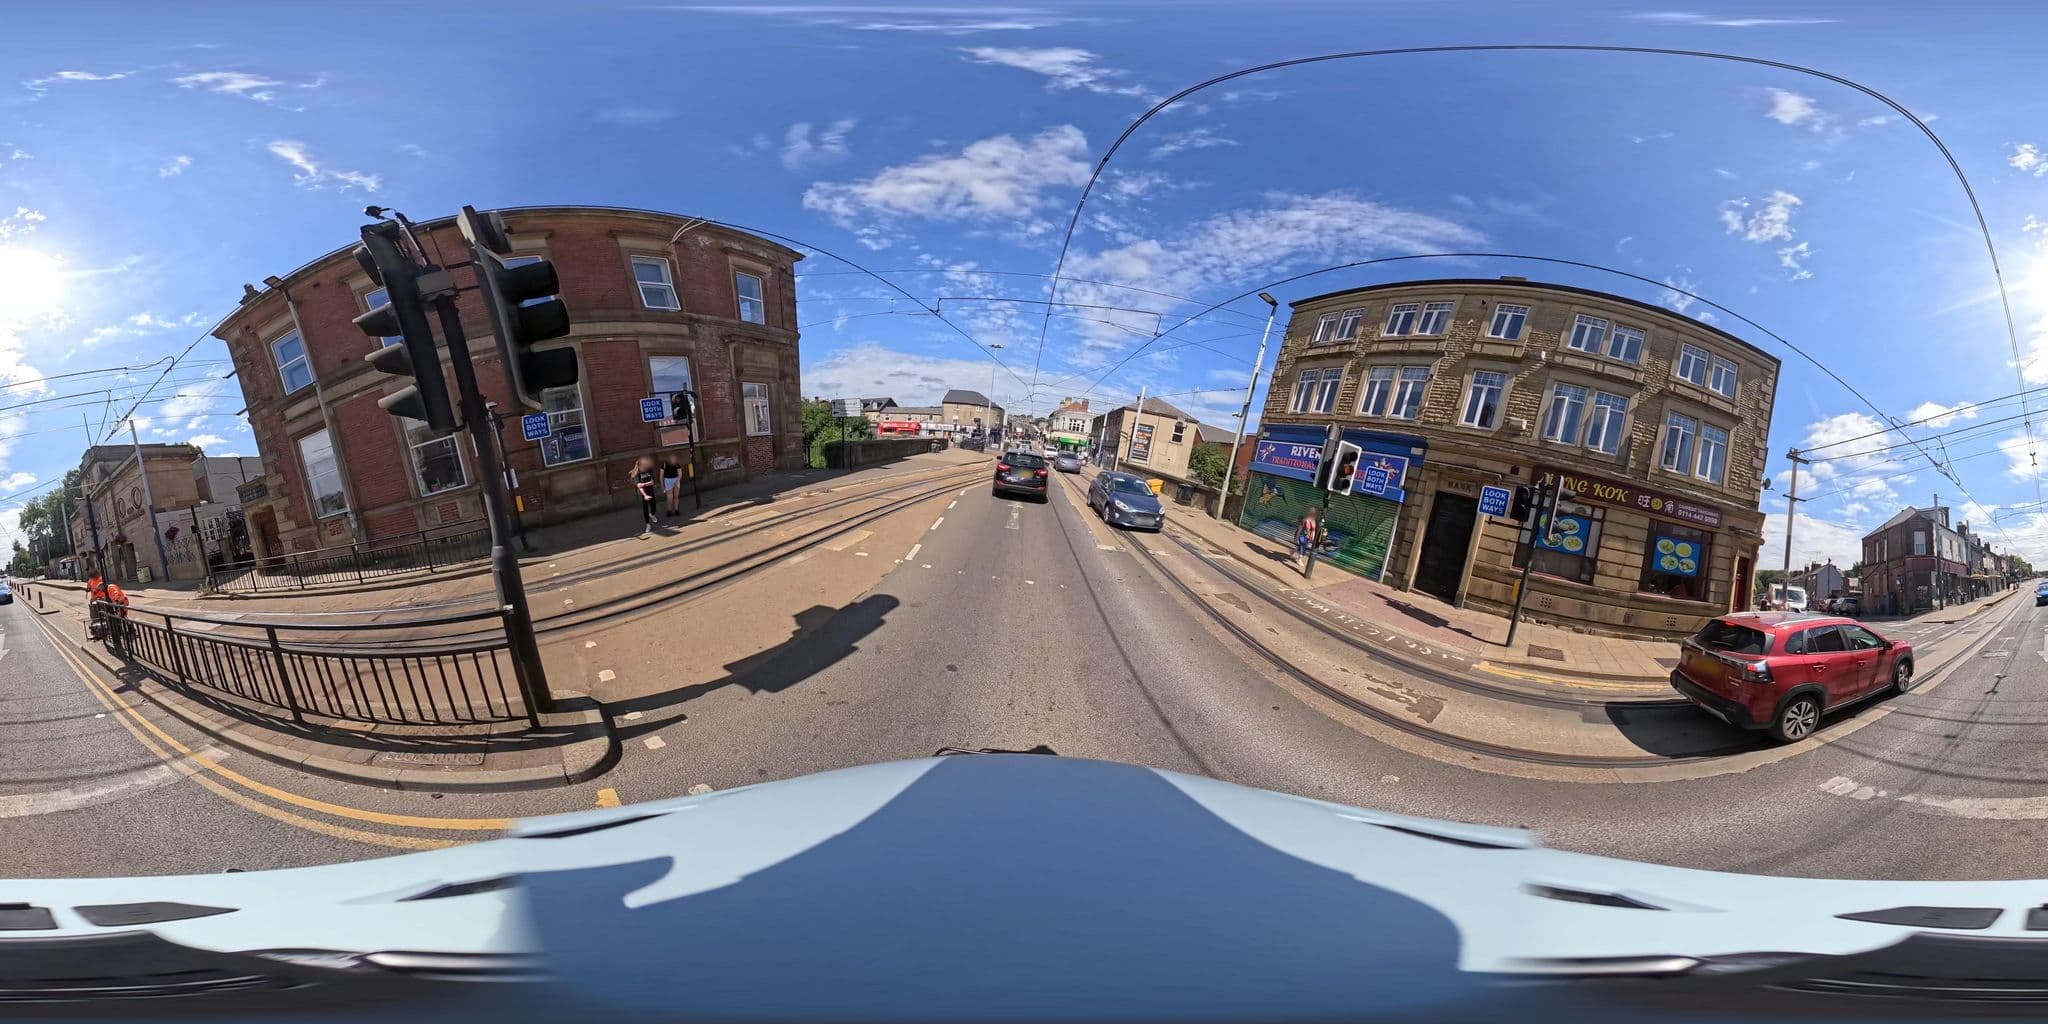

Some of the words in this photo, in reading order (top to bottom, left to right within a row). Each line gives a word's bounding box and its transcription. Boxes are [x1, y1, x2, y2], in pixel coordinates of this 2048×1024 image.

[525, 415, 546, 424] LOOK
[526, 422, 546, 431] BOTH
[527, 429, 548, 437] WAYS
[1272, 456, 1316, 471] TRADITIONAL
[1368, 469, 1386, 478] LOOK
[1366, 475, 1384, 484] BOTH
[1365, 482, 1383, 491] WAYS
[1485, 489, 1507, 499] LOOK
[1593, 482, 1629, 503] KOK
[1483, 497, 1505, 506] BOTH
[1482, 504, 1504, 514] WAYS
[1677, 509, 1692, 518] 0114
